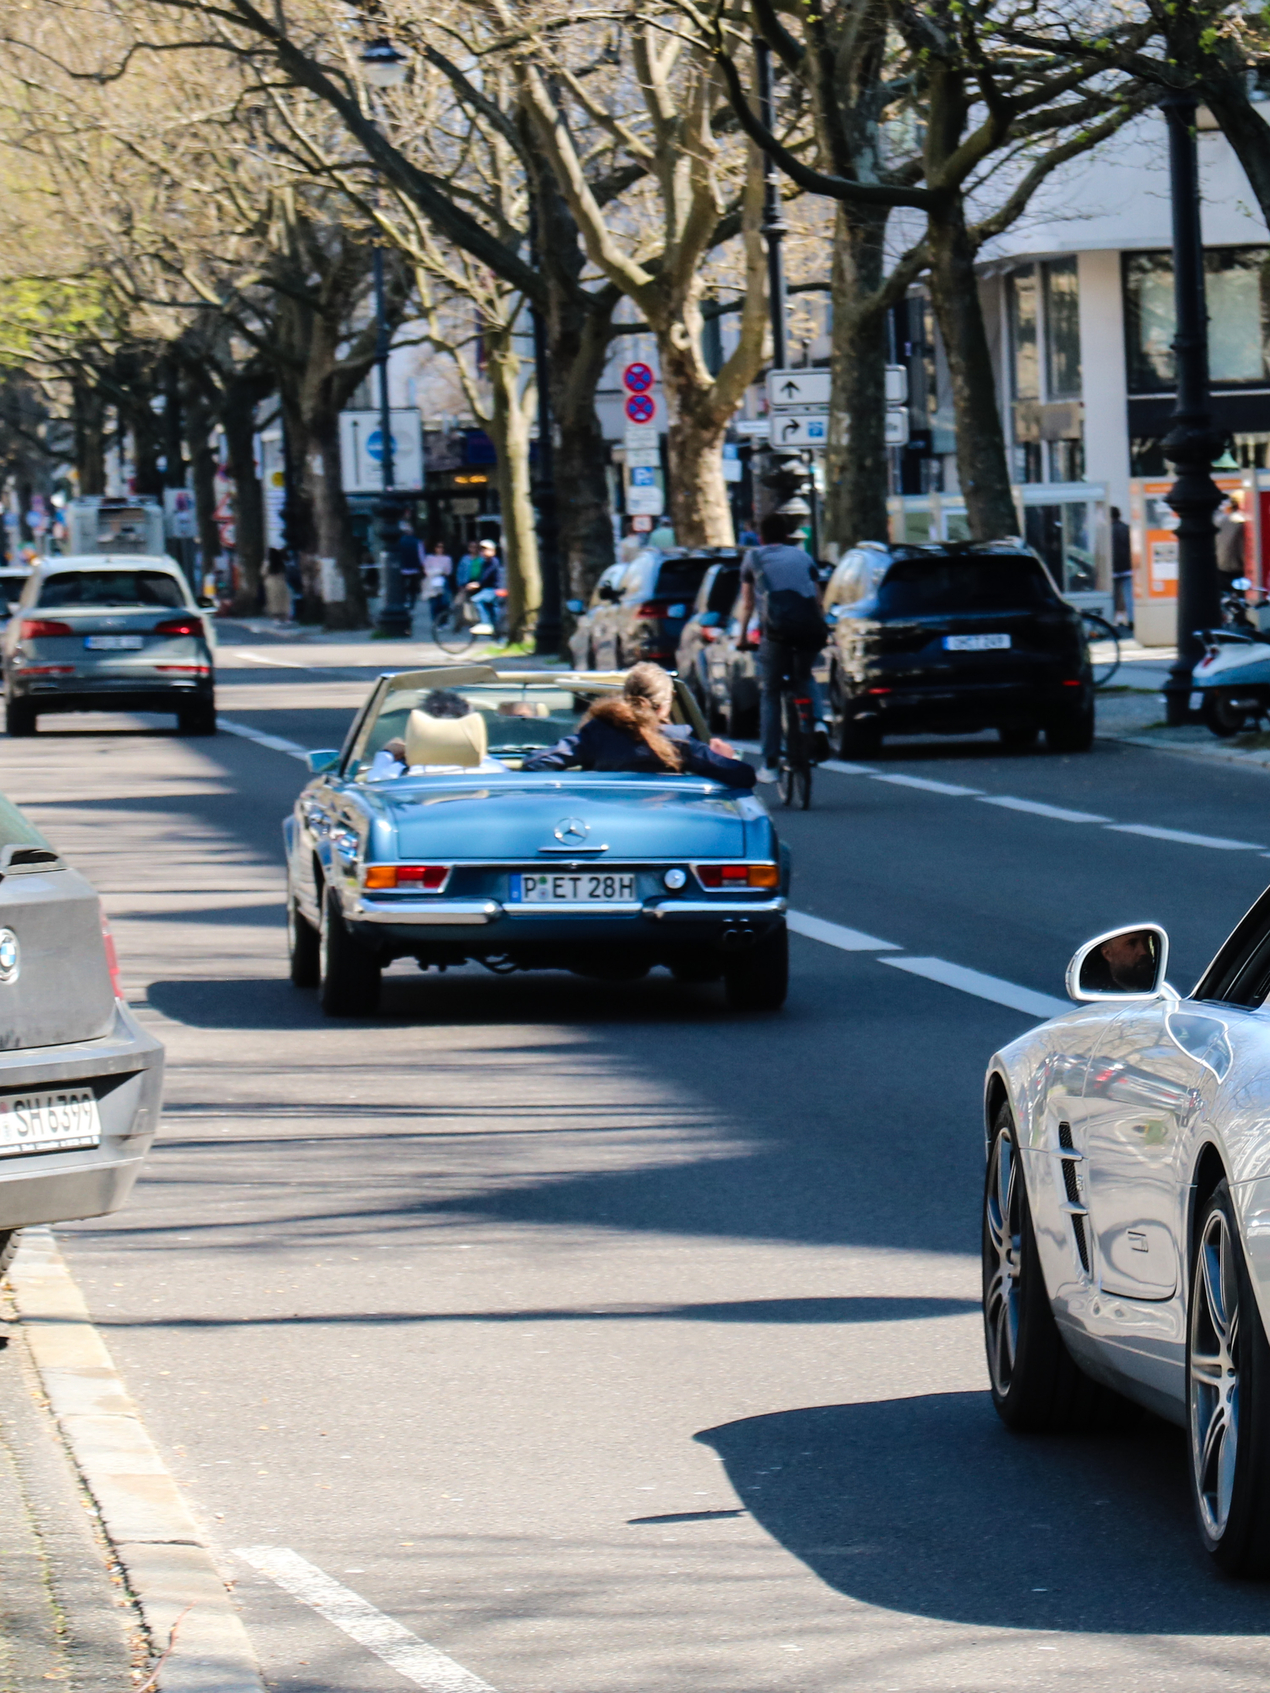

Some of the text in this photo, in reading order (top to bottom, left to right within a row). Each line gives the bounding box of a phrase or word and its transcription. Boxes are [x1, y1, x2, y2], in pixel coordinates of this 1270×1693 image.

[523, 876, 634, 898] P ET 28H
[14, 1097, 44, 1137] SH
